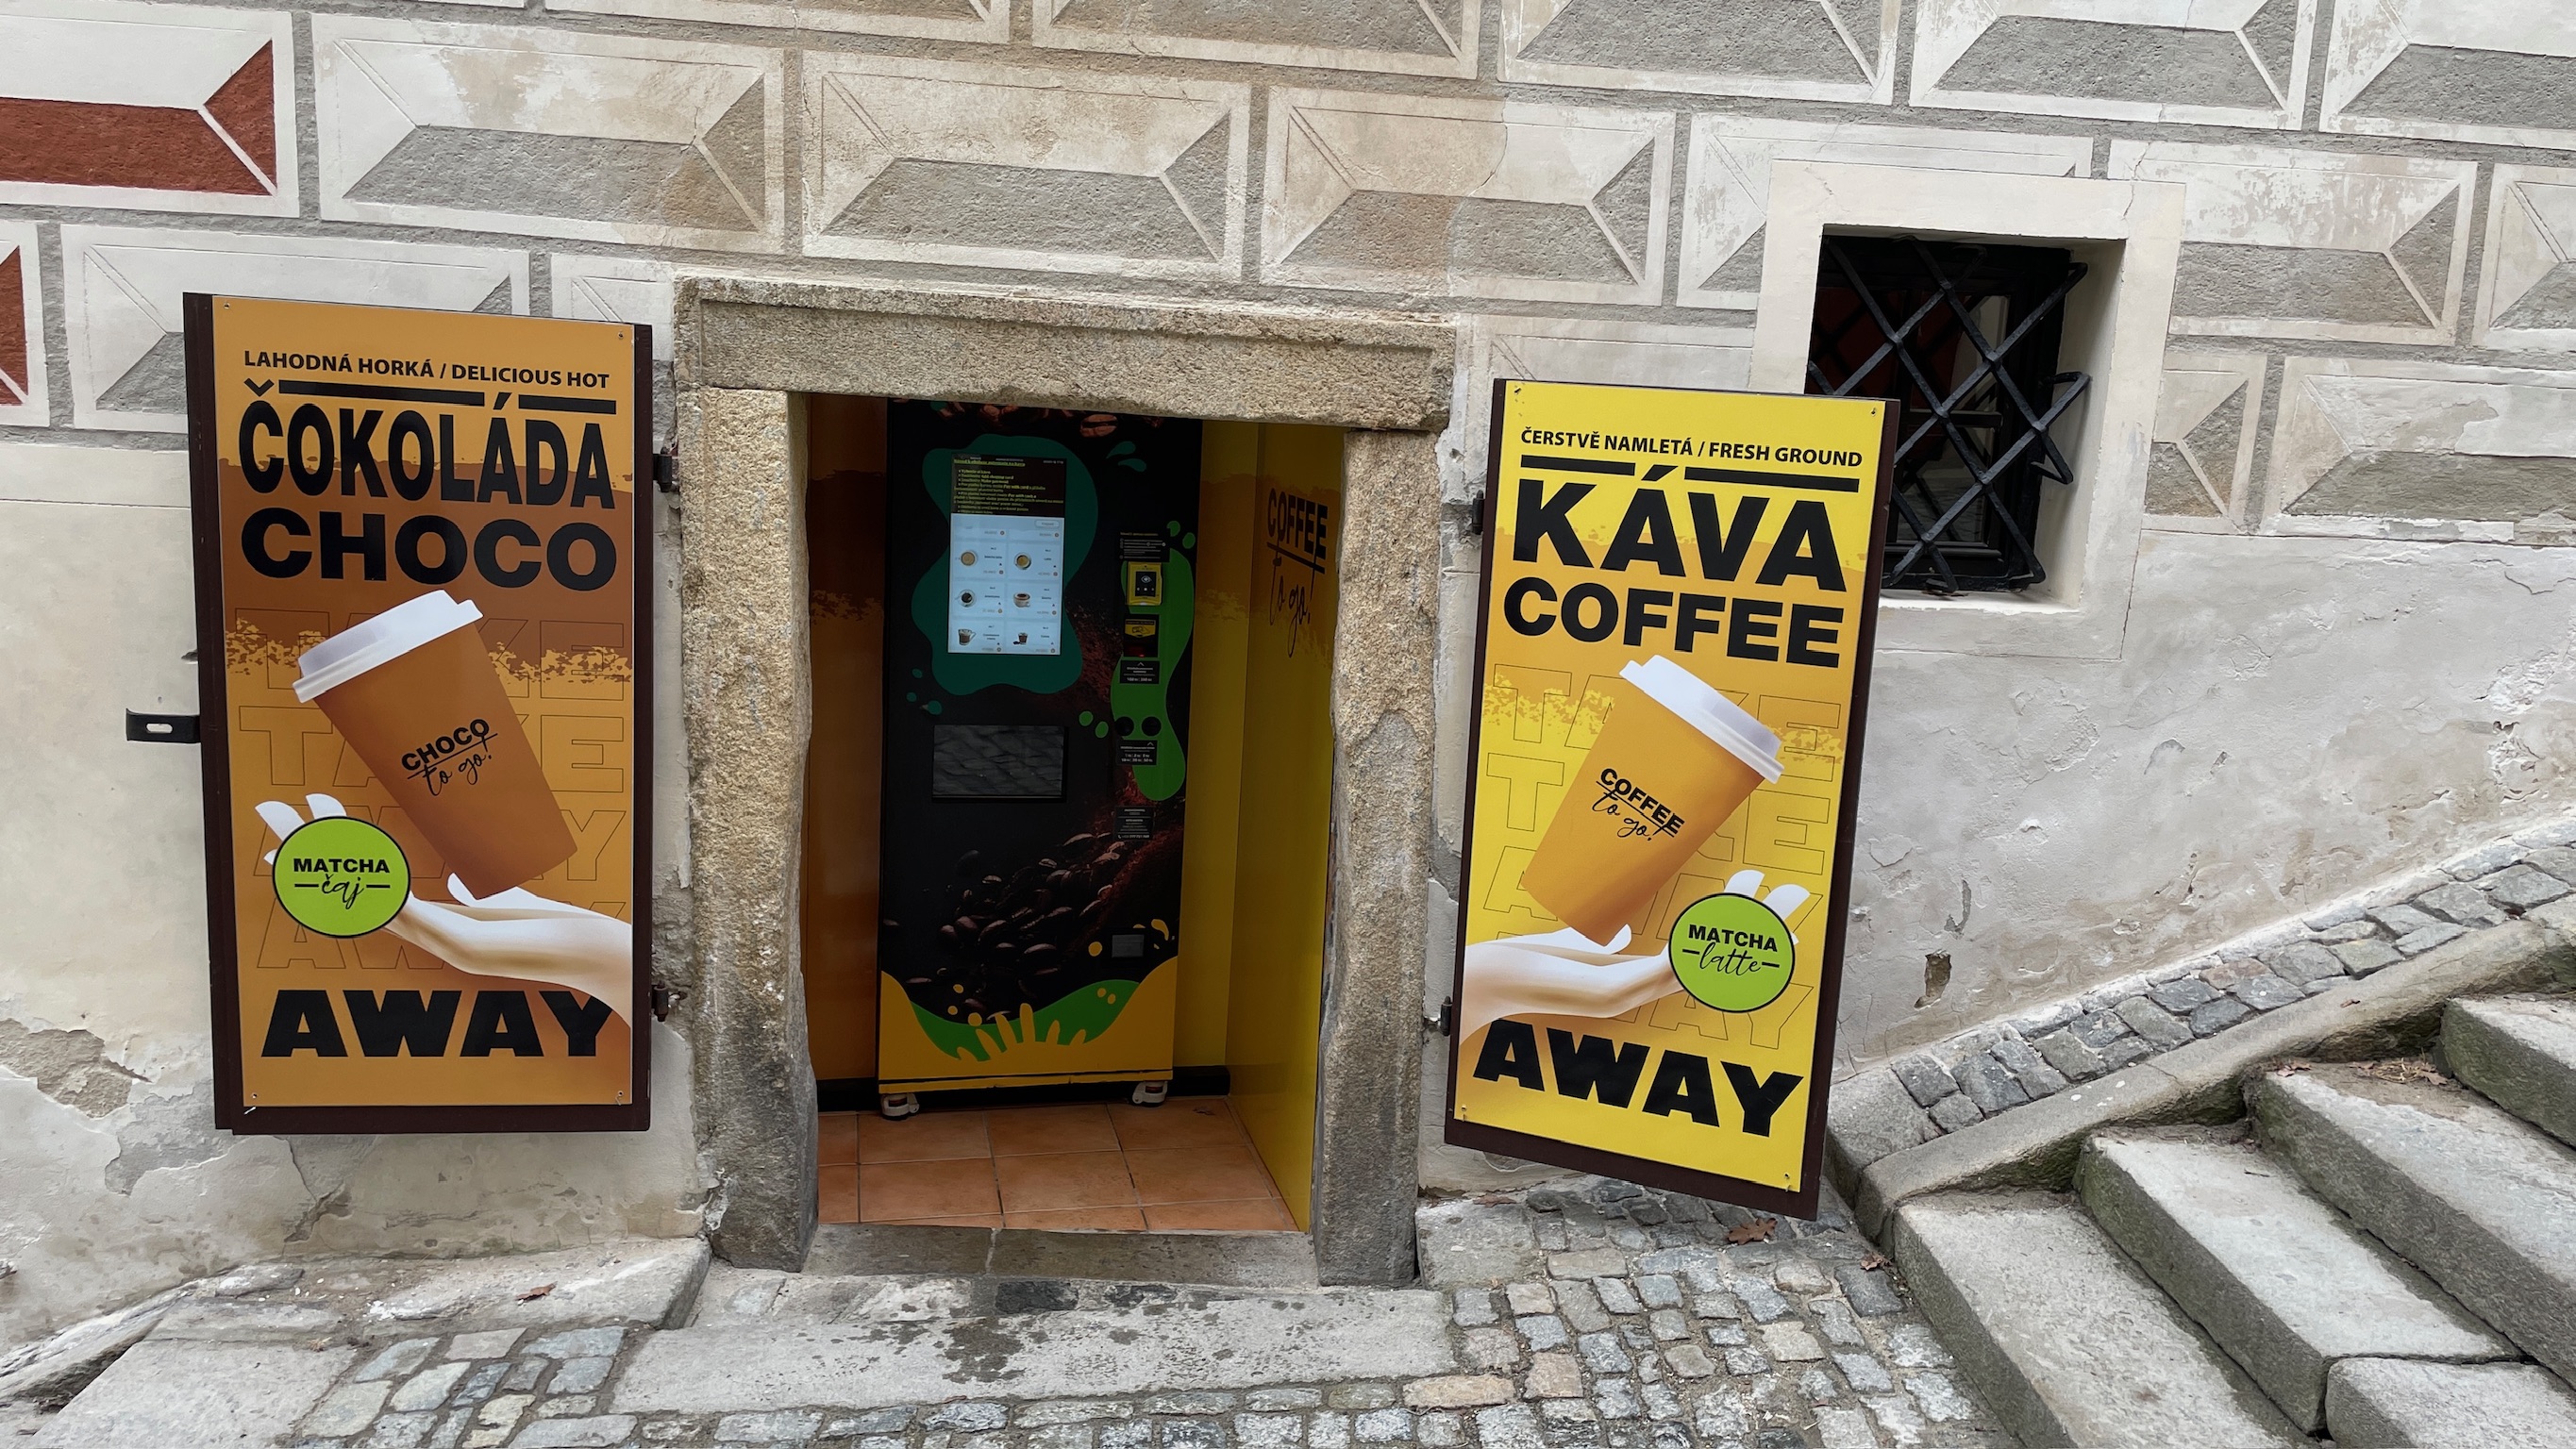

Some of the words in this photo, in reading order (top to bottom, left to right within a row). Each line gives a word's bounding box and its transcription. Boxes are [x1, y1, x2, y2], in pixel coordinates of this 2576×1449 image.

[244, 350, 353, 373] LAHODNÁ
[359, 358, 435, 378] HORKÁ
[440, 363, 446, 379] /
[452, 364, 562, 386] DELICIOUS
[567, 372, 611, 389] HOT
[239, 377, 616, 509] ČOKOLÁDA
[1521, 426, 1600, 449] ČERSTVĚ
[1604, 435, 1693, 456] NAMLETÁ
[1698, 441, 1705, 458] /
[1709, 441, 1770, 460] FRESH
[1775, 447, 1863, 467] GROUND
[241, 507, 618, 591] CHOCO
[1267, 488, 1329, 560] COFFEE
[1513, 463, 1848, 592] KÁVA
[1504, 576, 1845, 669] COFFEE
[401, 719, 490, 772] CHOCO
[423, 764, 453, 796] to
[1592, 790, 1620, 816] to
[1600, 768, 1685, 835] COFFEE
[293, 858, 390, 874] MATCHA
[321, 873, 364, 910] čaj
[1688, 924, 1778, 953] MATCHA
[1699, 941, 1761, 975] latte
[260, 989, 613, 1058] AWAY
[1473, 1018, 1804, 1138] AWAY
